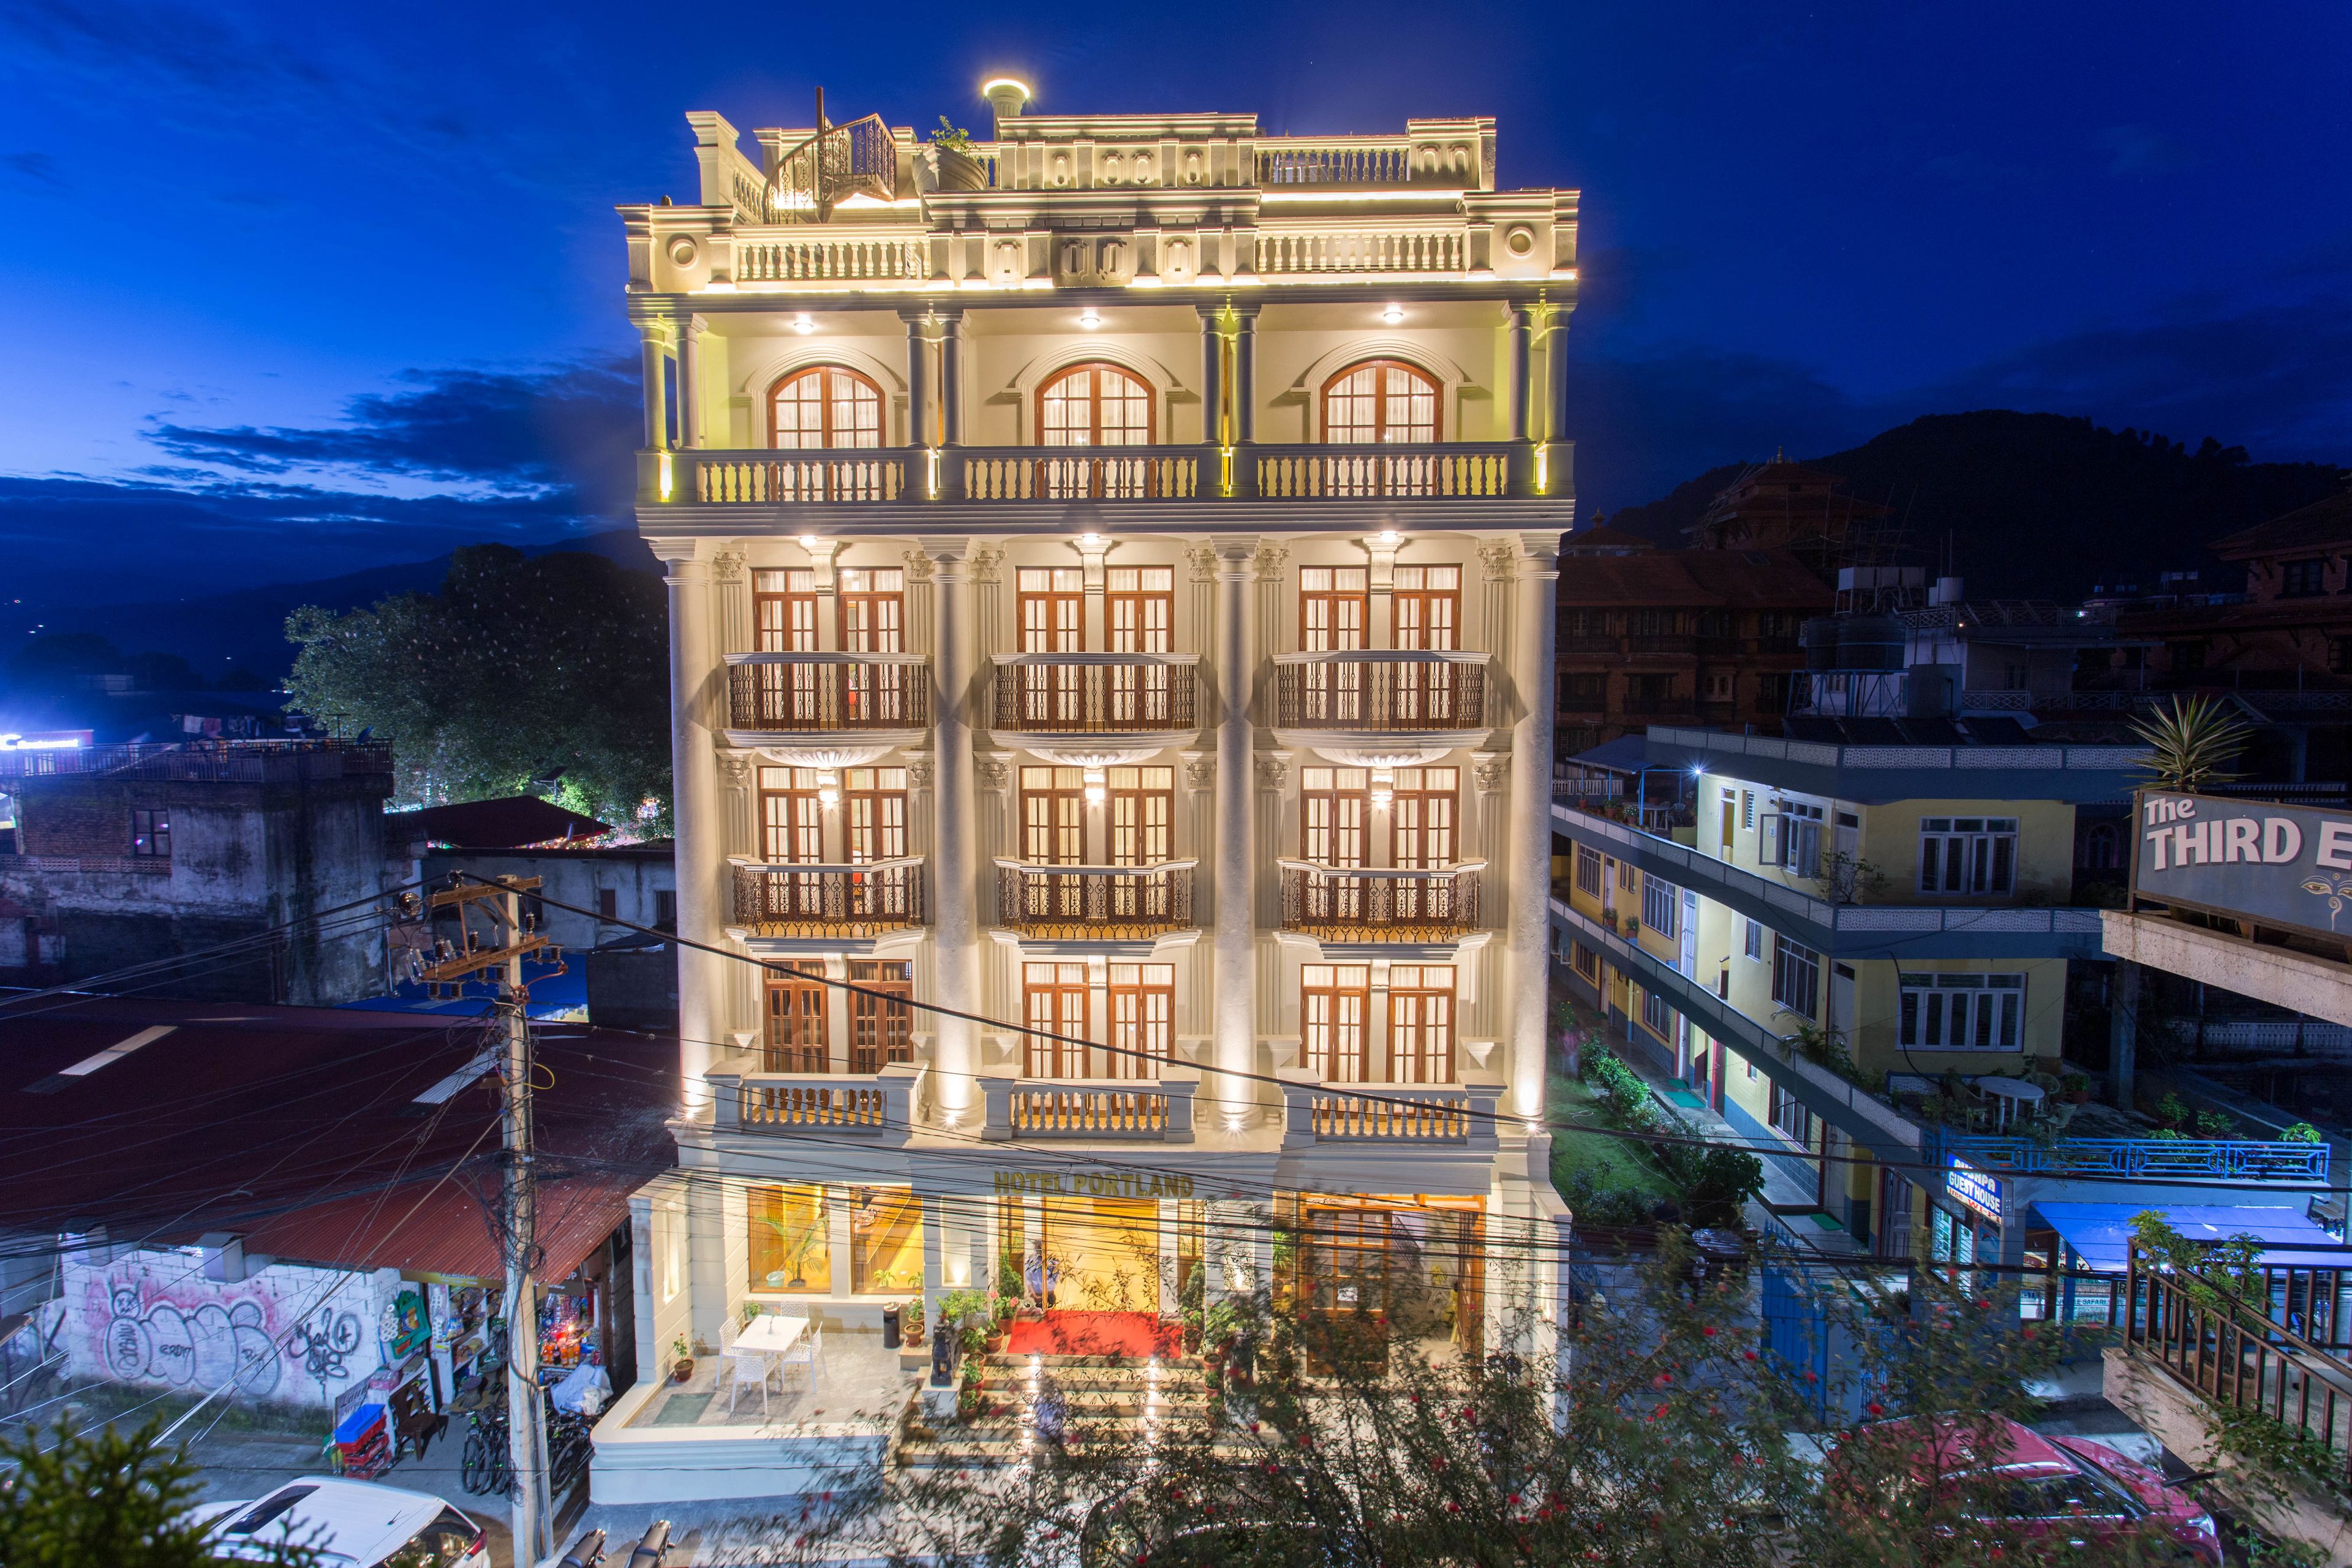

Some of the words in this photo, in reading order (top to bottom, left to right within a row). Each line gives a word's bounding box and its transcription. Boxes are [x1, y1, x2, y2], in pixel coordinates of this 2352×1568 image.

[2144, 798, 2196, 826] The
[2146, 818, 2302, 872] THIRD
[994, 1171, 1066, 1194] HOTEL
[1074, 1172, 1194, 1197] PORTLAND
[1949, 1170, 1974, 1197] GUEST
[1974, 1186, 2000, 1213] HOUSE
